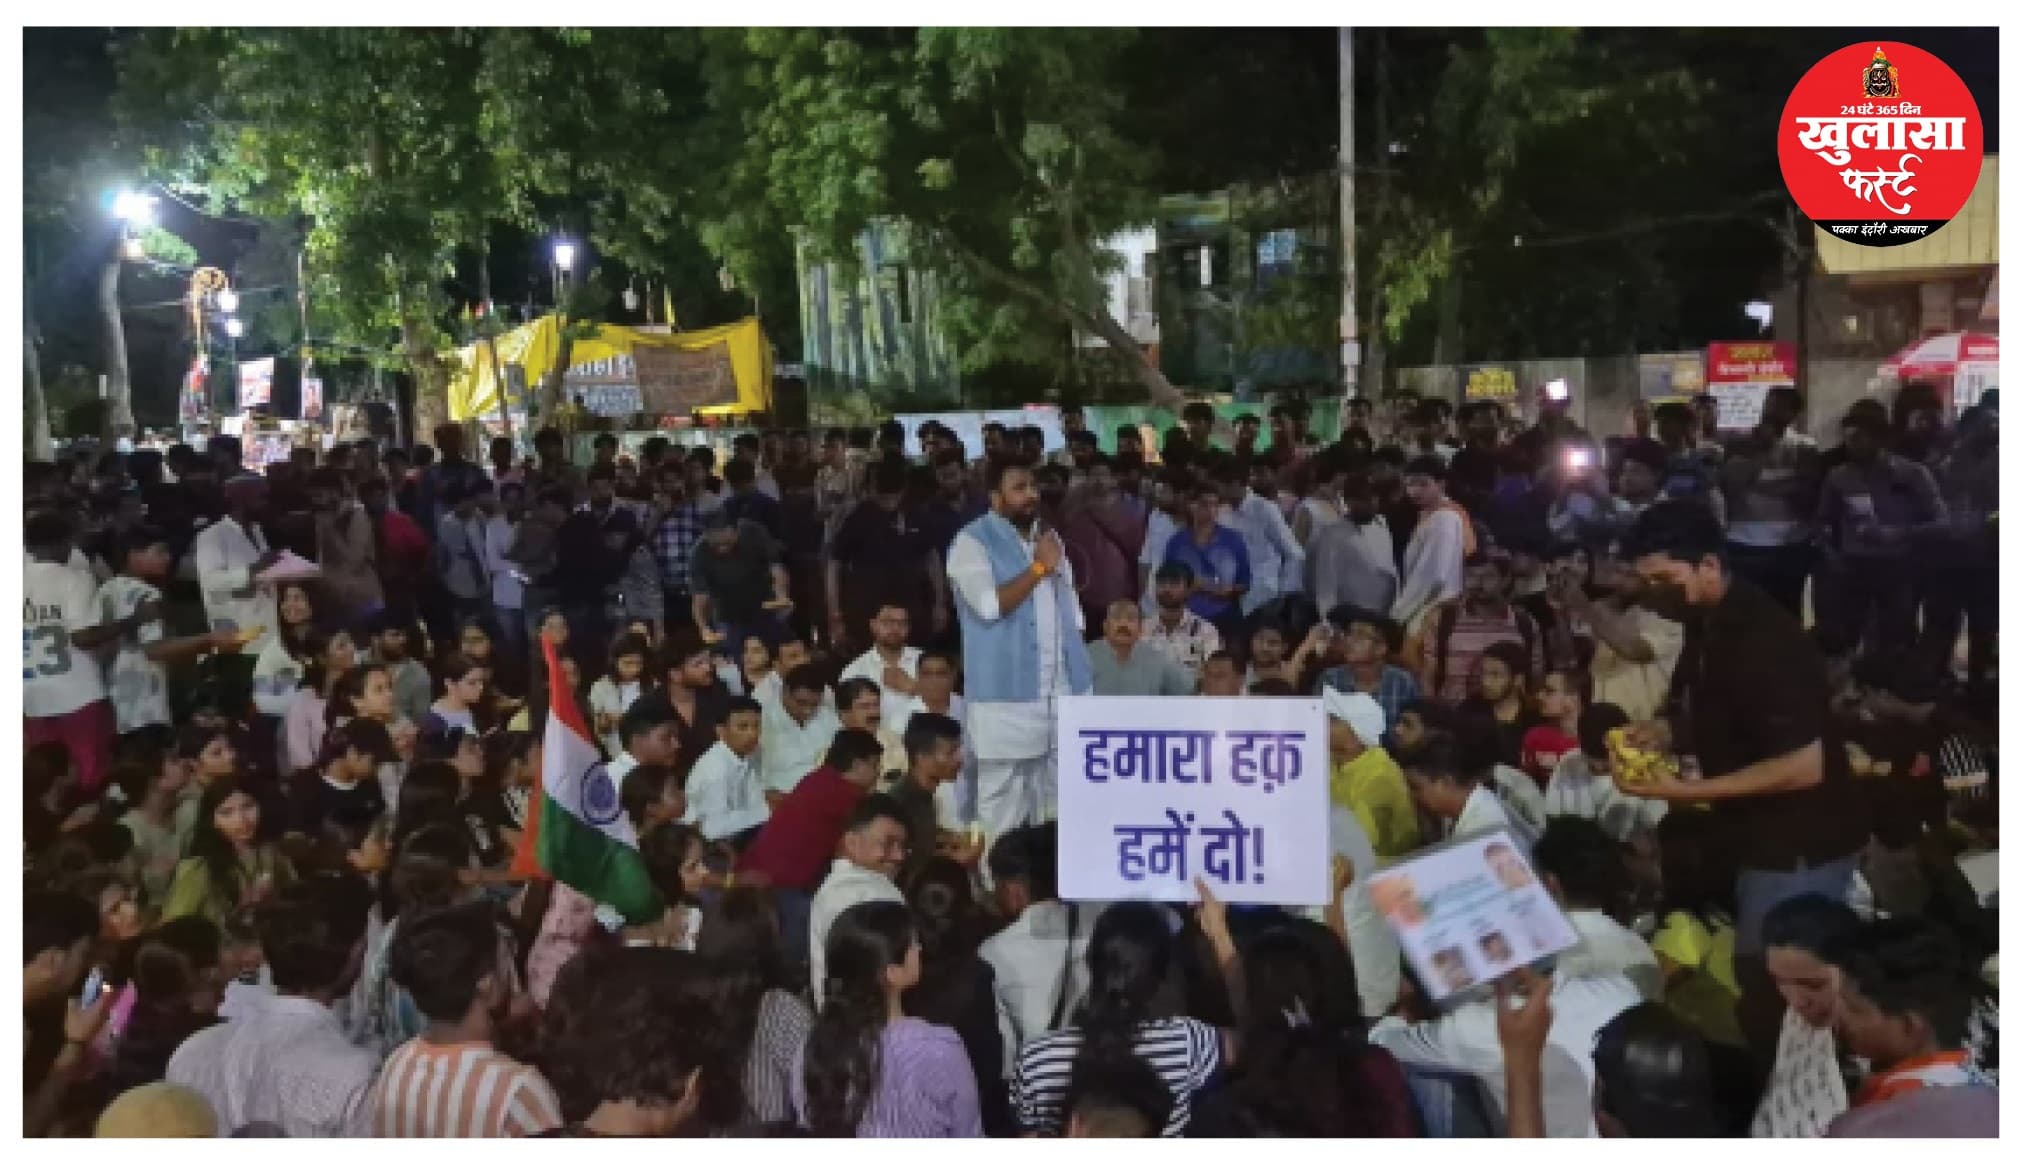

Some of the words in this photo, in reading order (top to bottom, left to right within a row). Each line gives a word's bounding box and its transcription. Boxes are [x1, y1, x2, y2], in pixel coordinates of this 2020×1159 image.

[1078, 730, 1215, 783] हमारा
[1225, 731, 1306, 793] हक़
[1114, 807, 1195, 881] हमें
[1199, 807, 1265, 884] दो!
